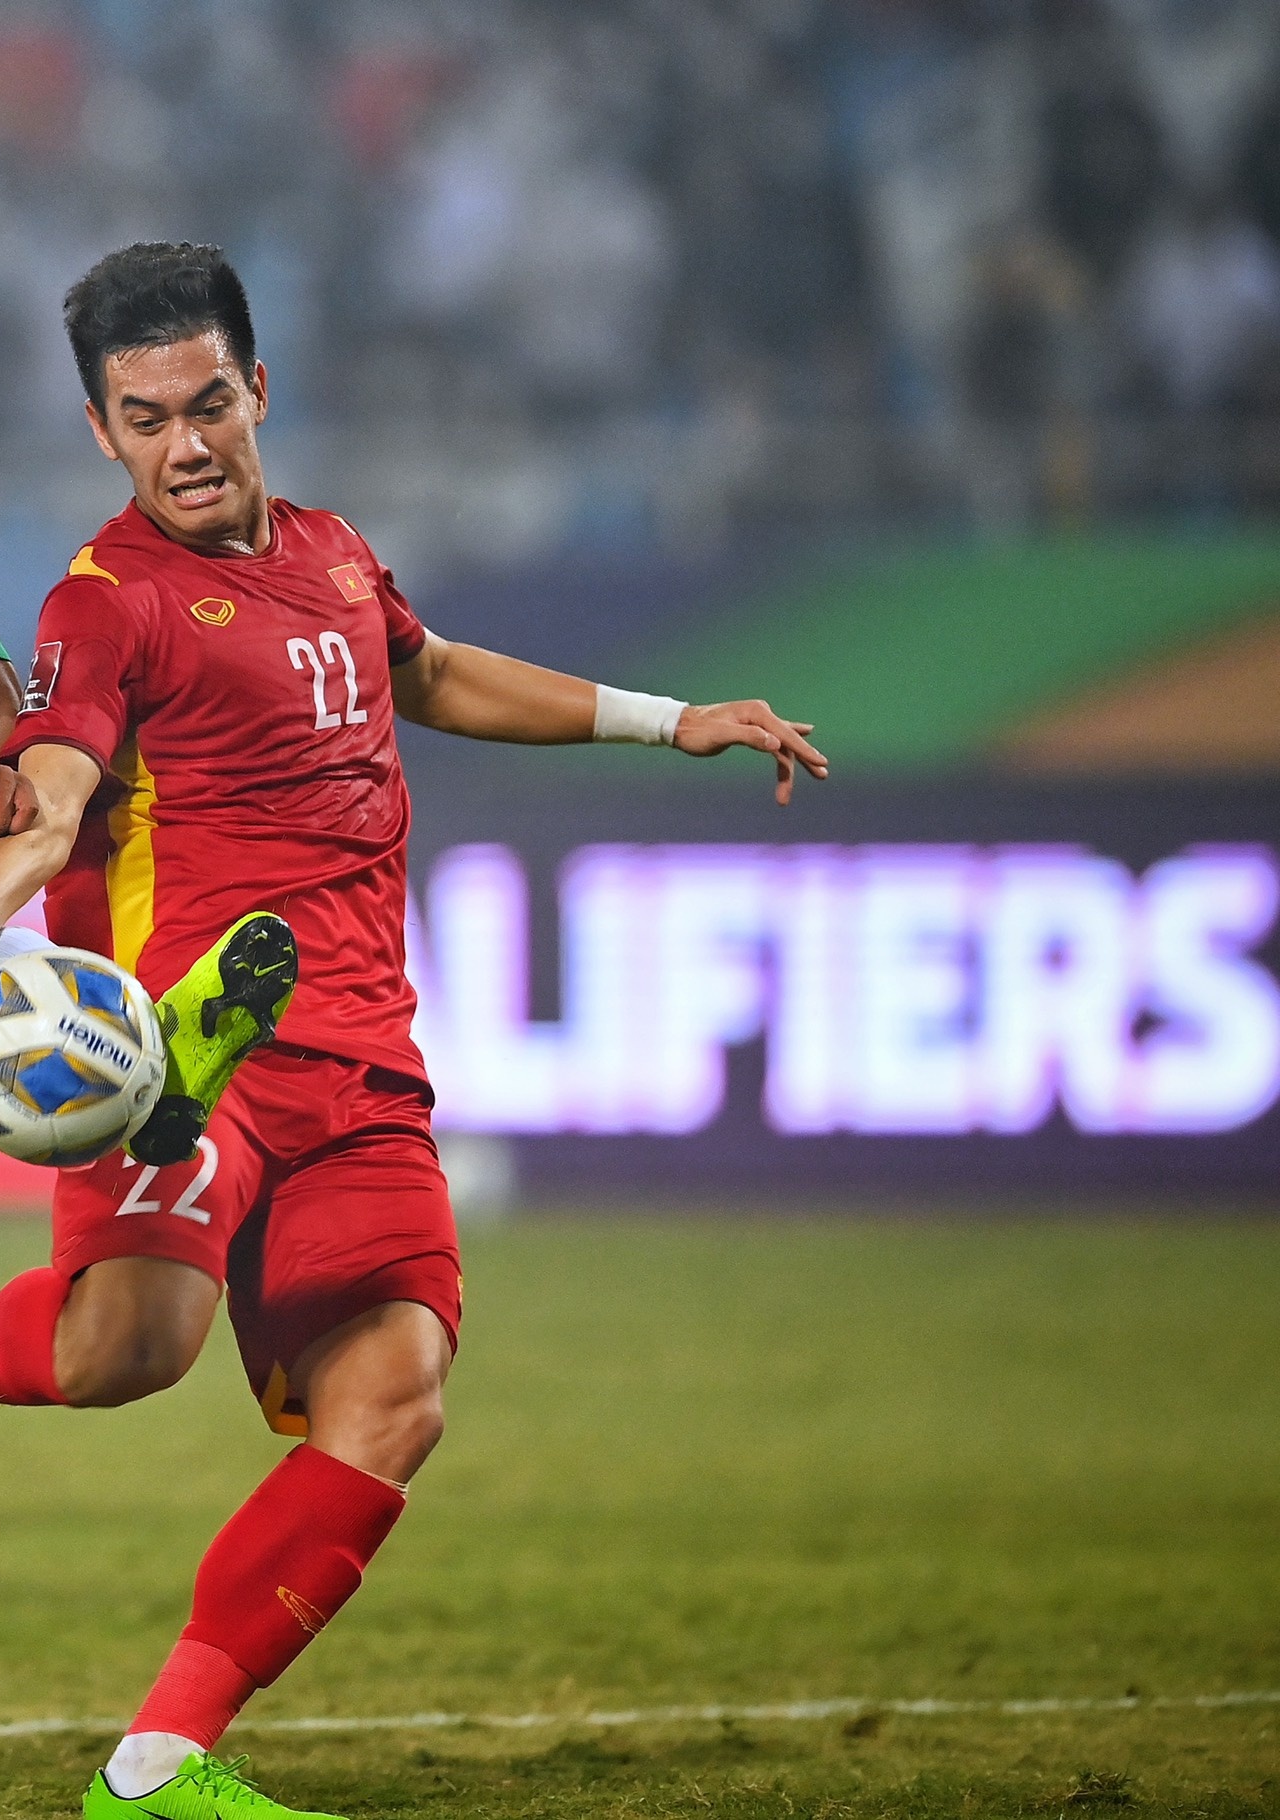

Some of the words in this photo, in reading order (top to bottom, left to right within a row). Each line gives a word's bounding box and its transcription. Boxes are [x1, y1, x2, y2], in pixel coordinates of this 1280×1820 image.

[286, 630, 368, 731] 22
[408, 842, 1280, 1134] LIFIERS
[58, 1014, 134, 1071] molten
